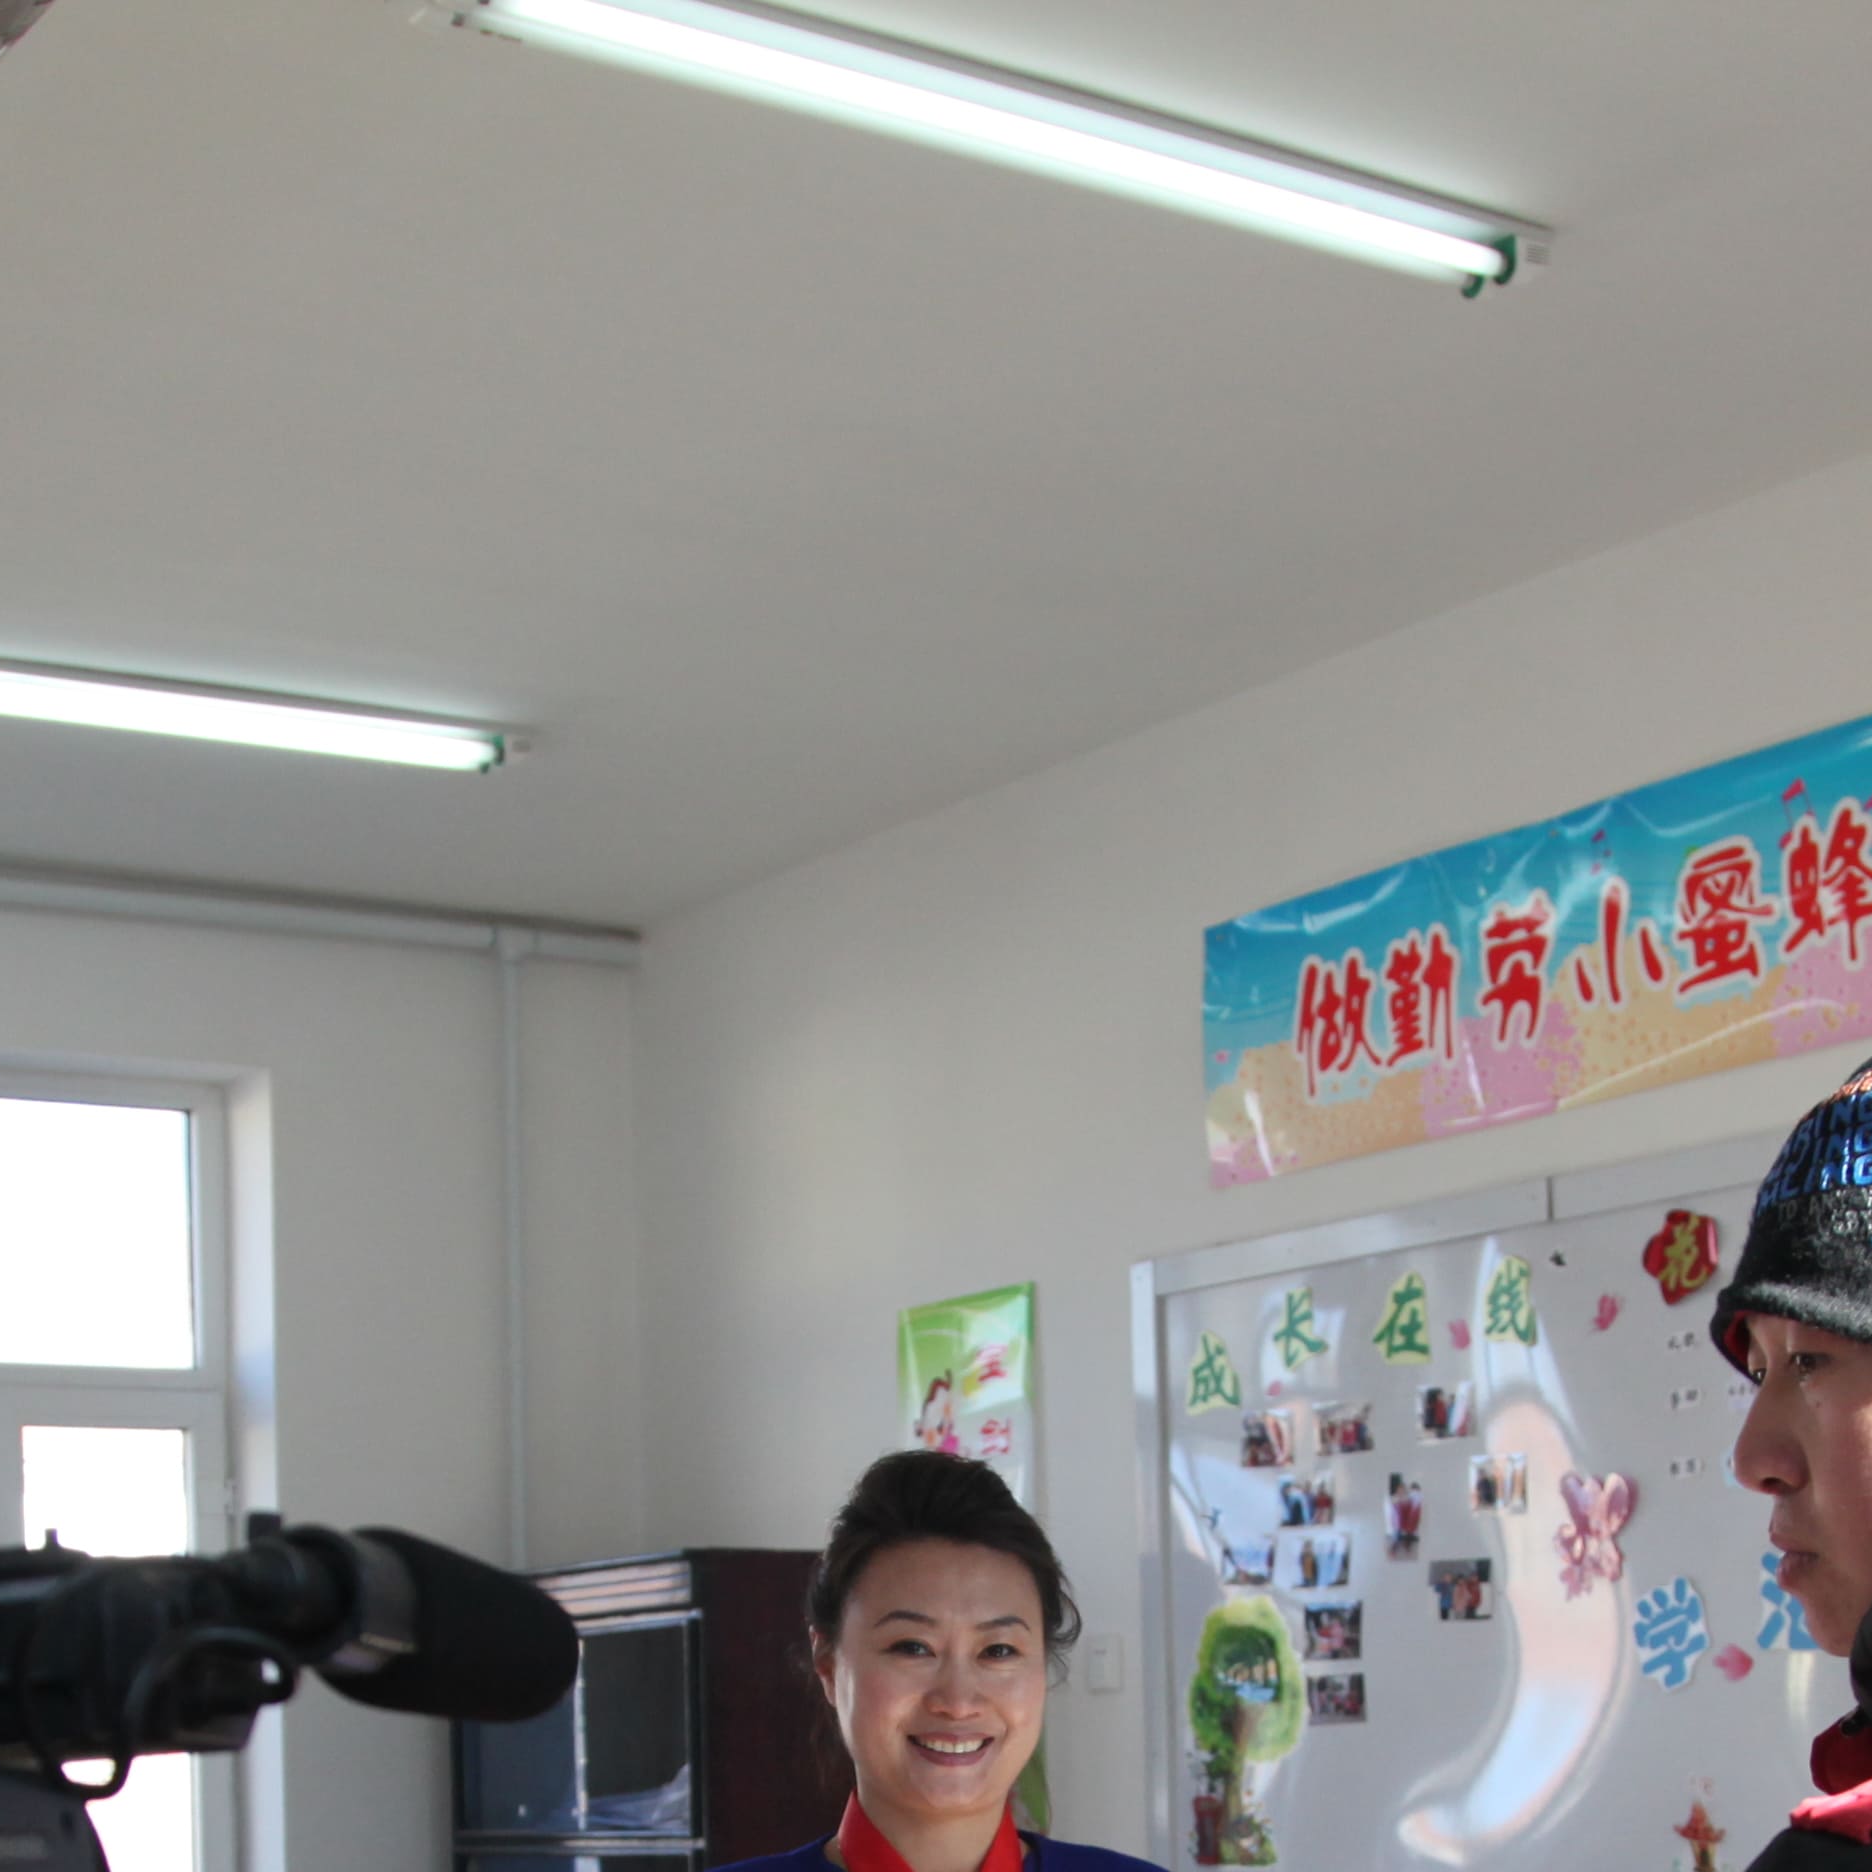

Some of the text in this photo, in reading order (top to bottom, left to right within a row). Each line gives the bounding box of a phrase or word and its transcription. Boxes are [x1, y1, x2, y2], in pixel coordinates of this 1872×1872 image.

[1659, 1216, 1710, 1292] 花
[1188, 1268, 1534, 1409] 成长在线
